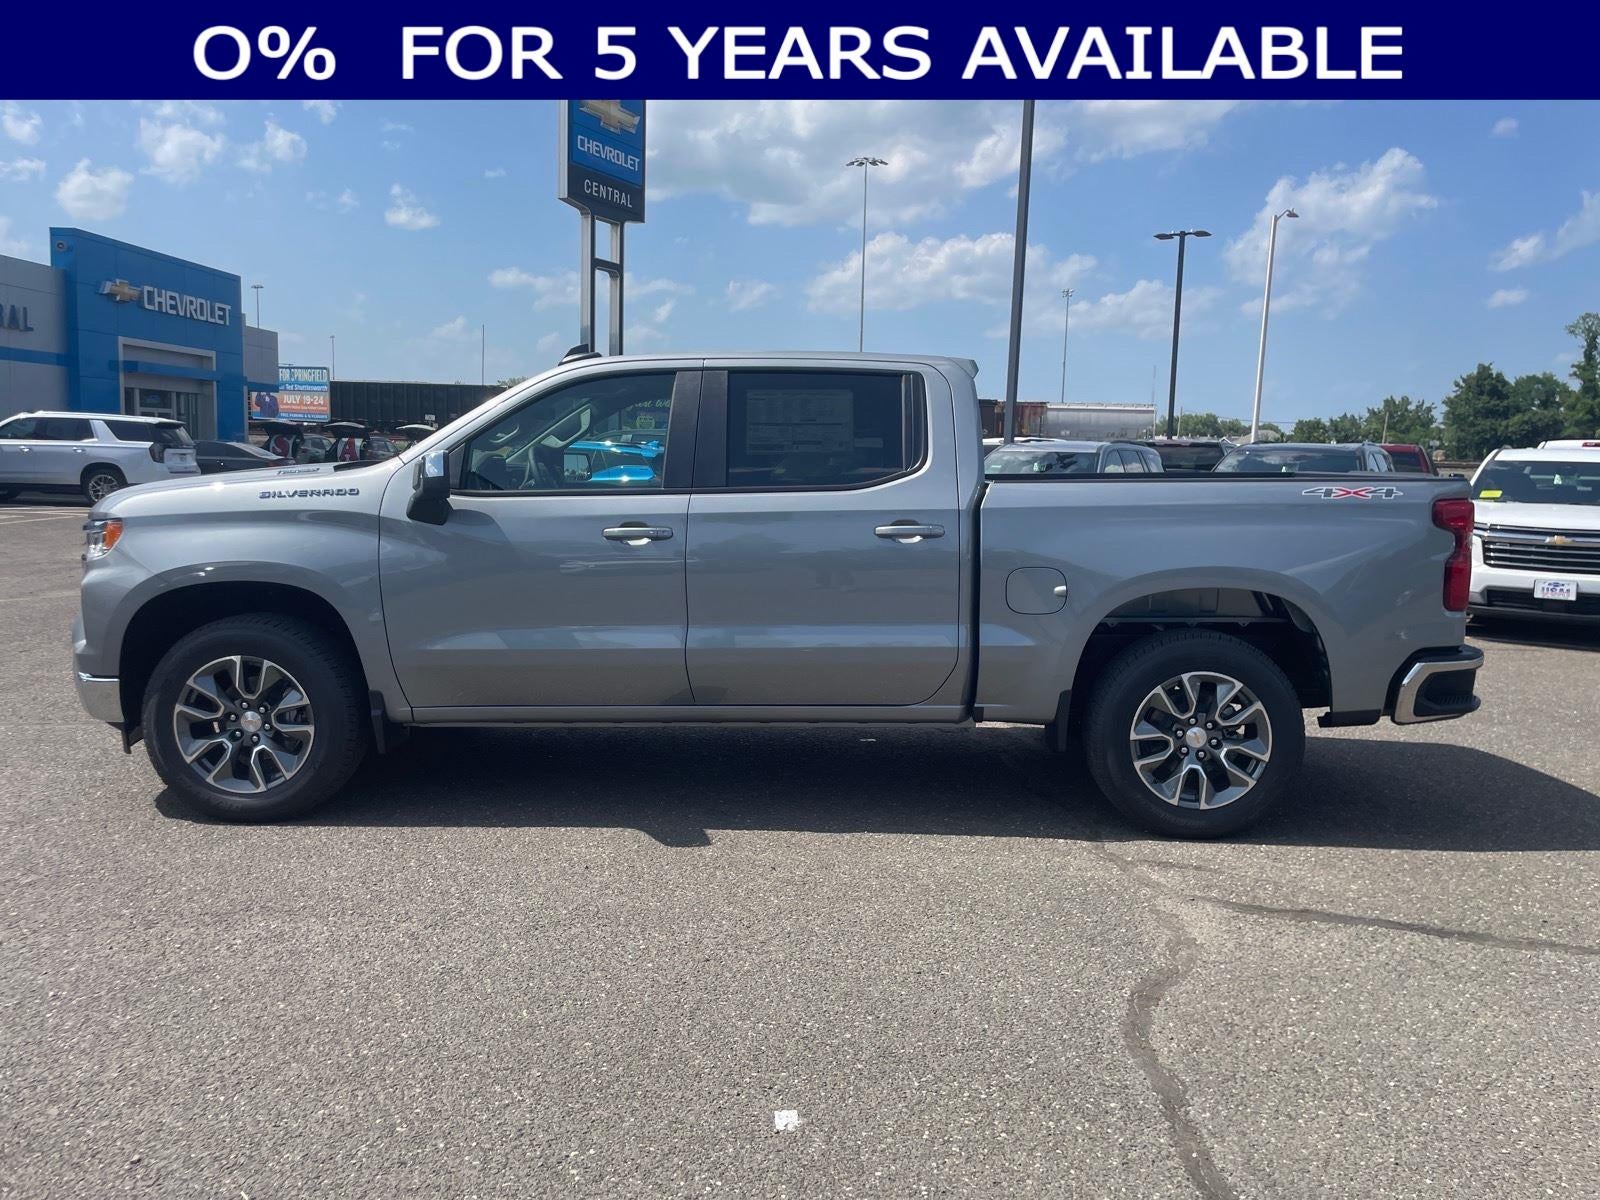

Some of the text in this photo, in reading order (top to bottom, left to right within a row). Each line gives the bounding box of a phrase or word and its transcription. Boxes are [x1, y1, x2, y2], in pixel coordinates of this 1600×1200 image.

[577, 135, 640, 172] CHEVROLET
[584, 179, 633, 208] CENTRAL
[143, 286, 232, 326] CHEVROLET
[291, 368, 328, 382] SPRINGFIELD
[283, 394, 324, 406] JULY 19-24
[259, 487, 360, 499] SILVERADO
